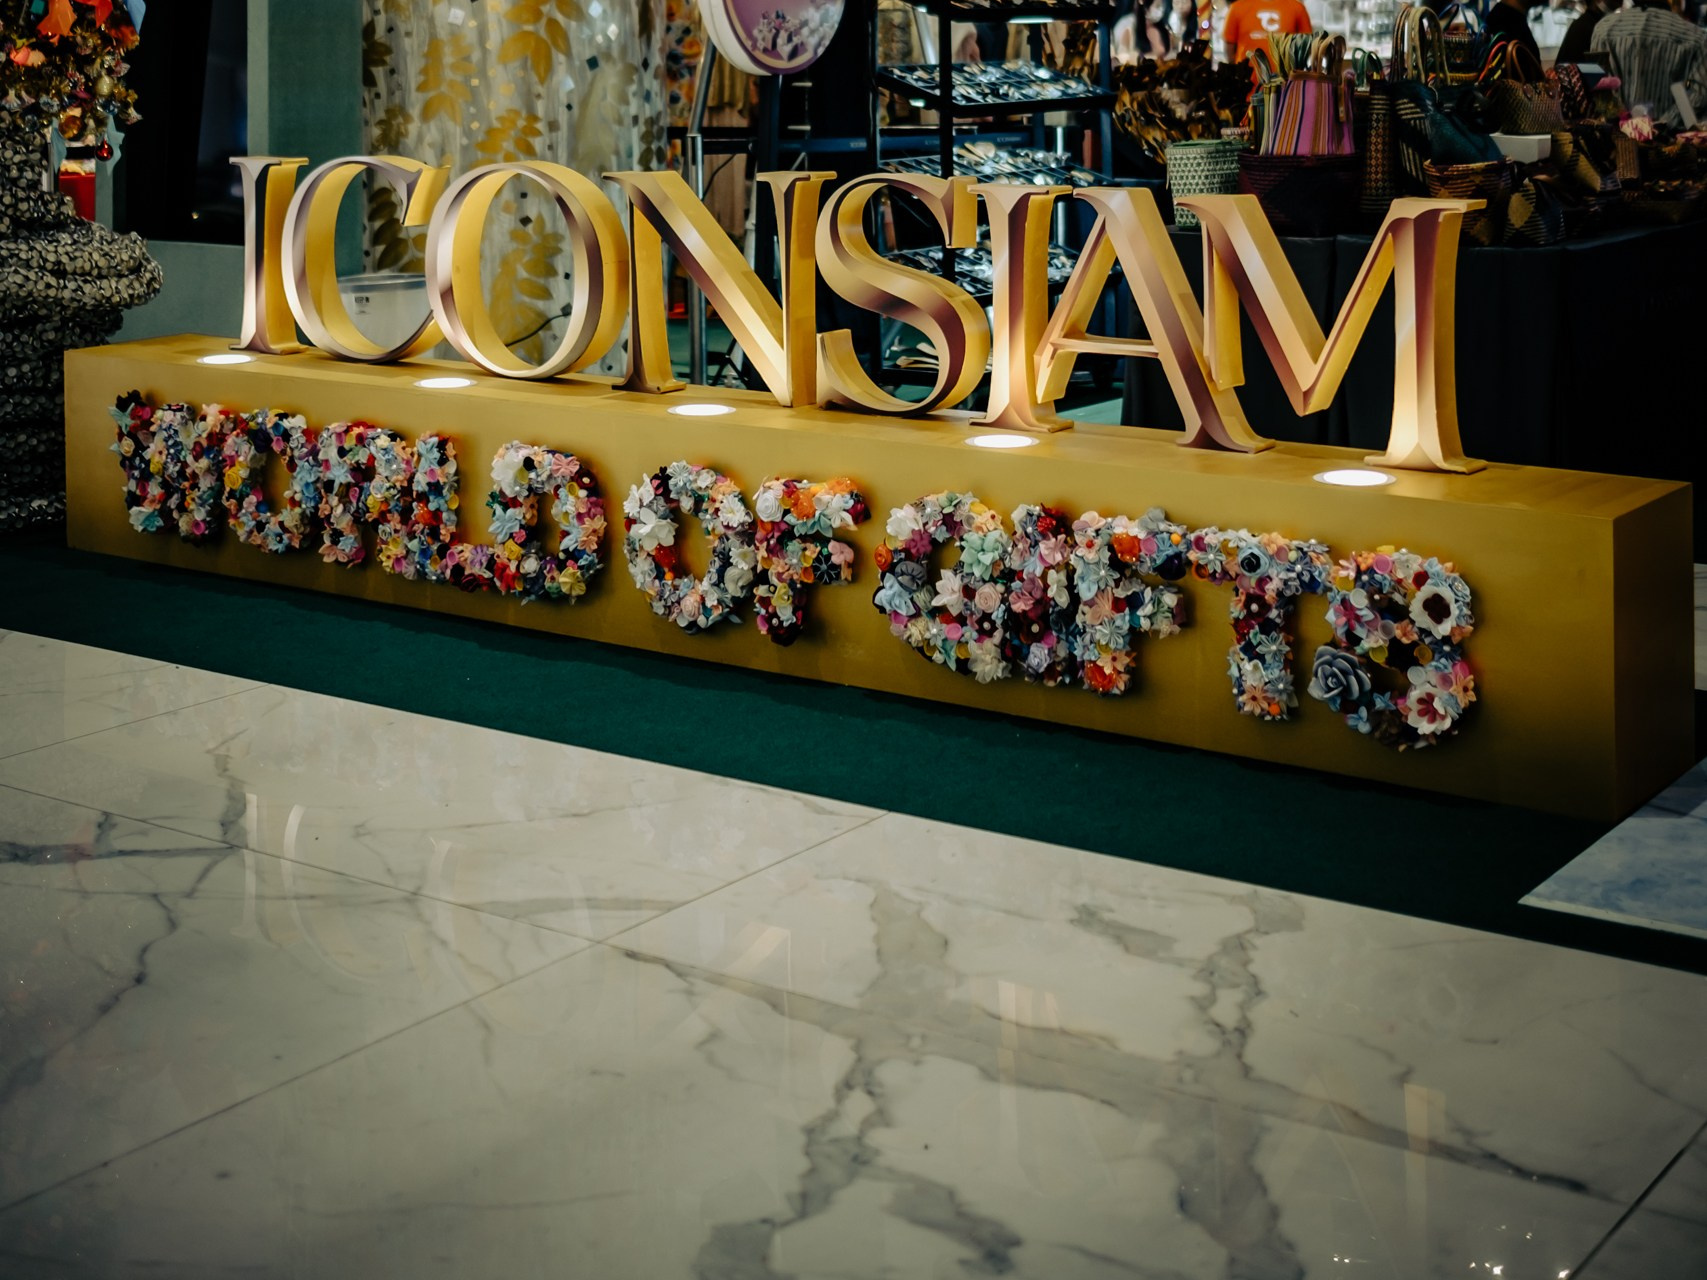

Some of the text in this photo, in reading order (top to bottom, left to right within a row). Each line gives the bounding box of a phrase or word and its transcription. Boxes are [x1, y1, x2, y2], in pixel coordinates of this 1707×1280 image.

[229, 155, 1487, 474] ICONSIAM
[109, 388, 608, 606] WORLD
[622, 459, 872, 646] OF
